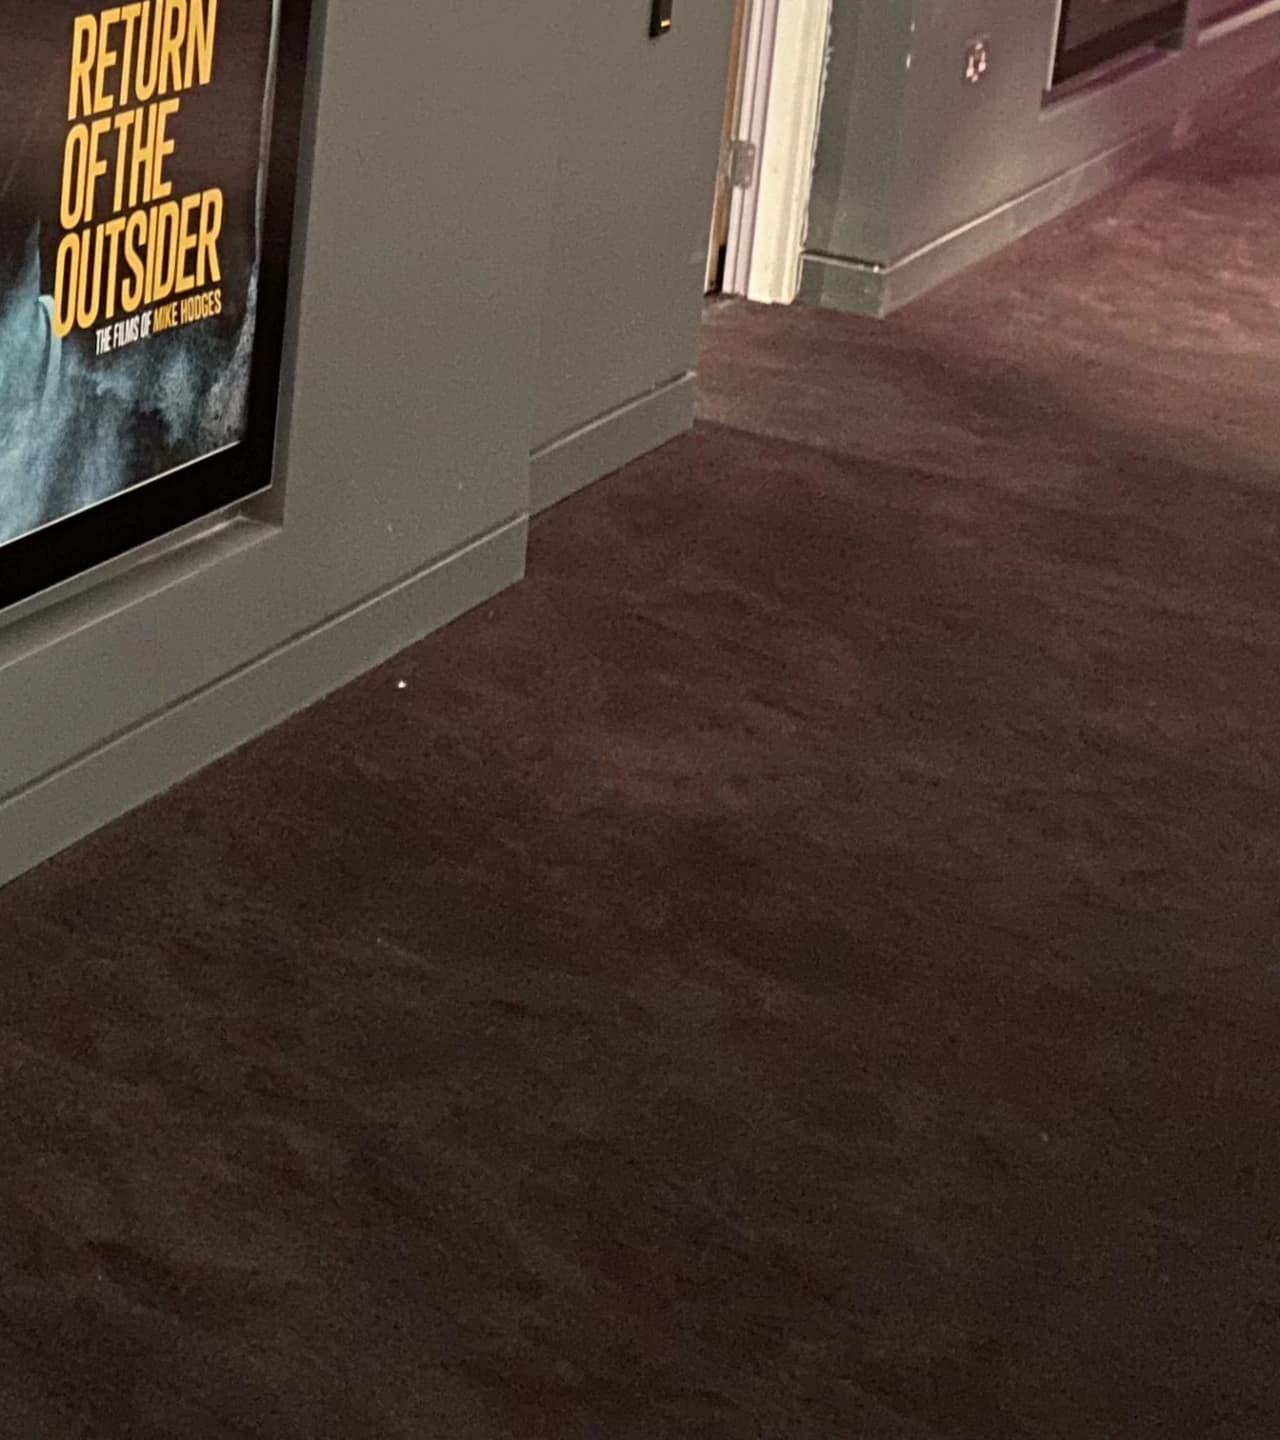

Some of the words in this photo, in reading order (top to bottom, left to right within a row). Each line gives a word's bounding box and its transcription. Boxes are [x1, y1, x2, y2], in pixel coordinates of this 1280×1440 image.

[59, 117, 111, 231] OF
[112, 97, 180, 213] THE
[52, 187, 224, 339] OUTSIDER
[96, 325, 112, 356] THE
[113, 315, 140, 349] FILMS
[140, 310, 153, 339] OF
[152, 301, 179, 333] MIKE
[180, 288, 222, 325] HODGES
